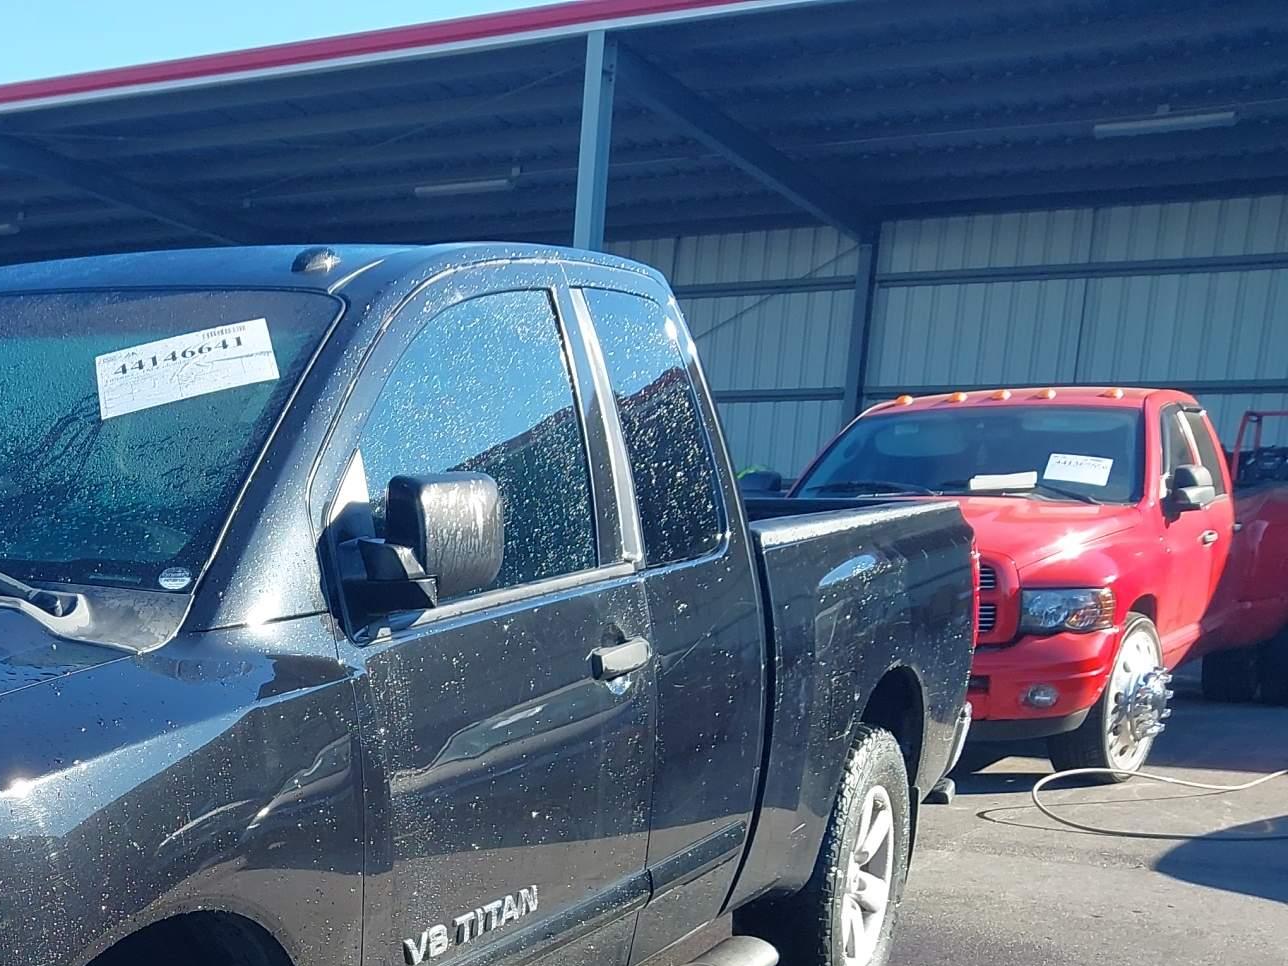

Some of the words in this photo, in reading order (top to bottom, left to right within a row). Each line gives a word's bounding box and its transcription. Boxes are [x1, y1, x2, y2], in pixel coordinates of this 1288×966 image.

[113, 335, 243, 375] 44146641
[403, 923, 449, 966] V8
[452, 884, 539, 945] TITAN
